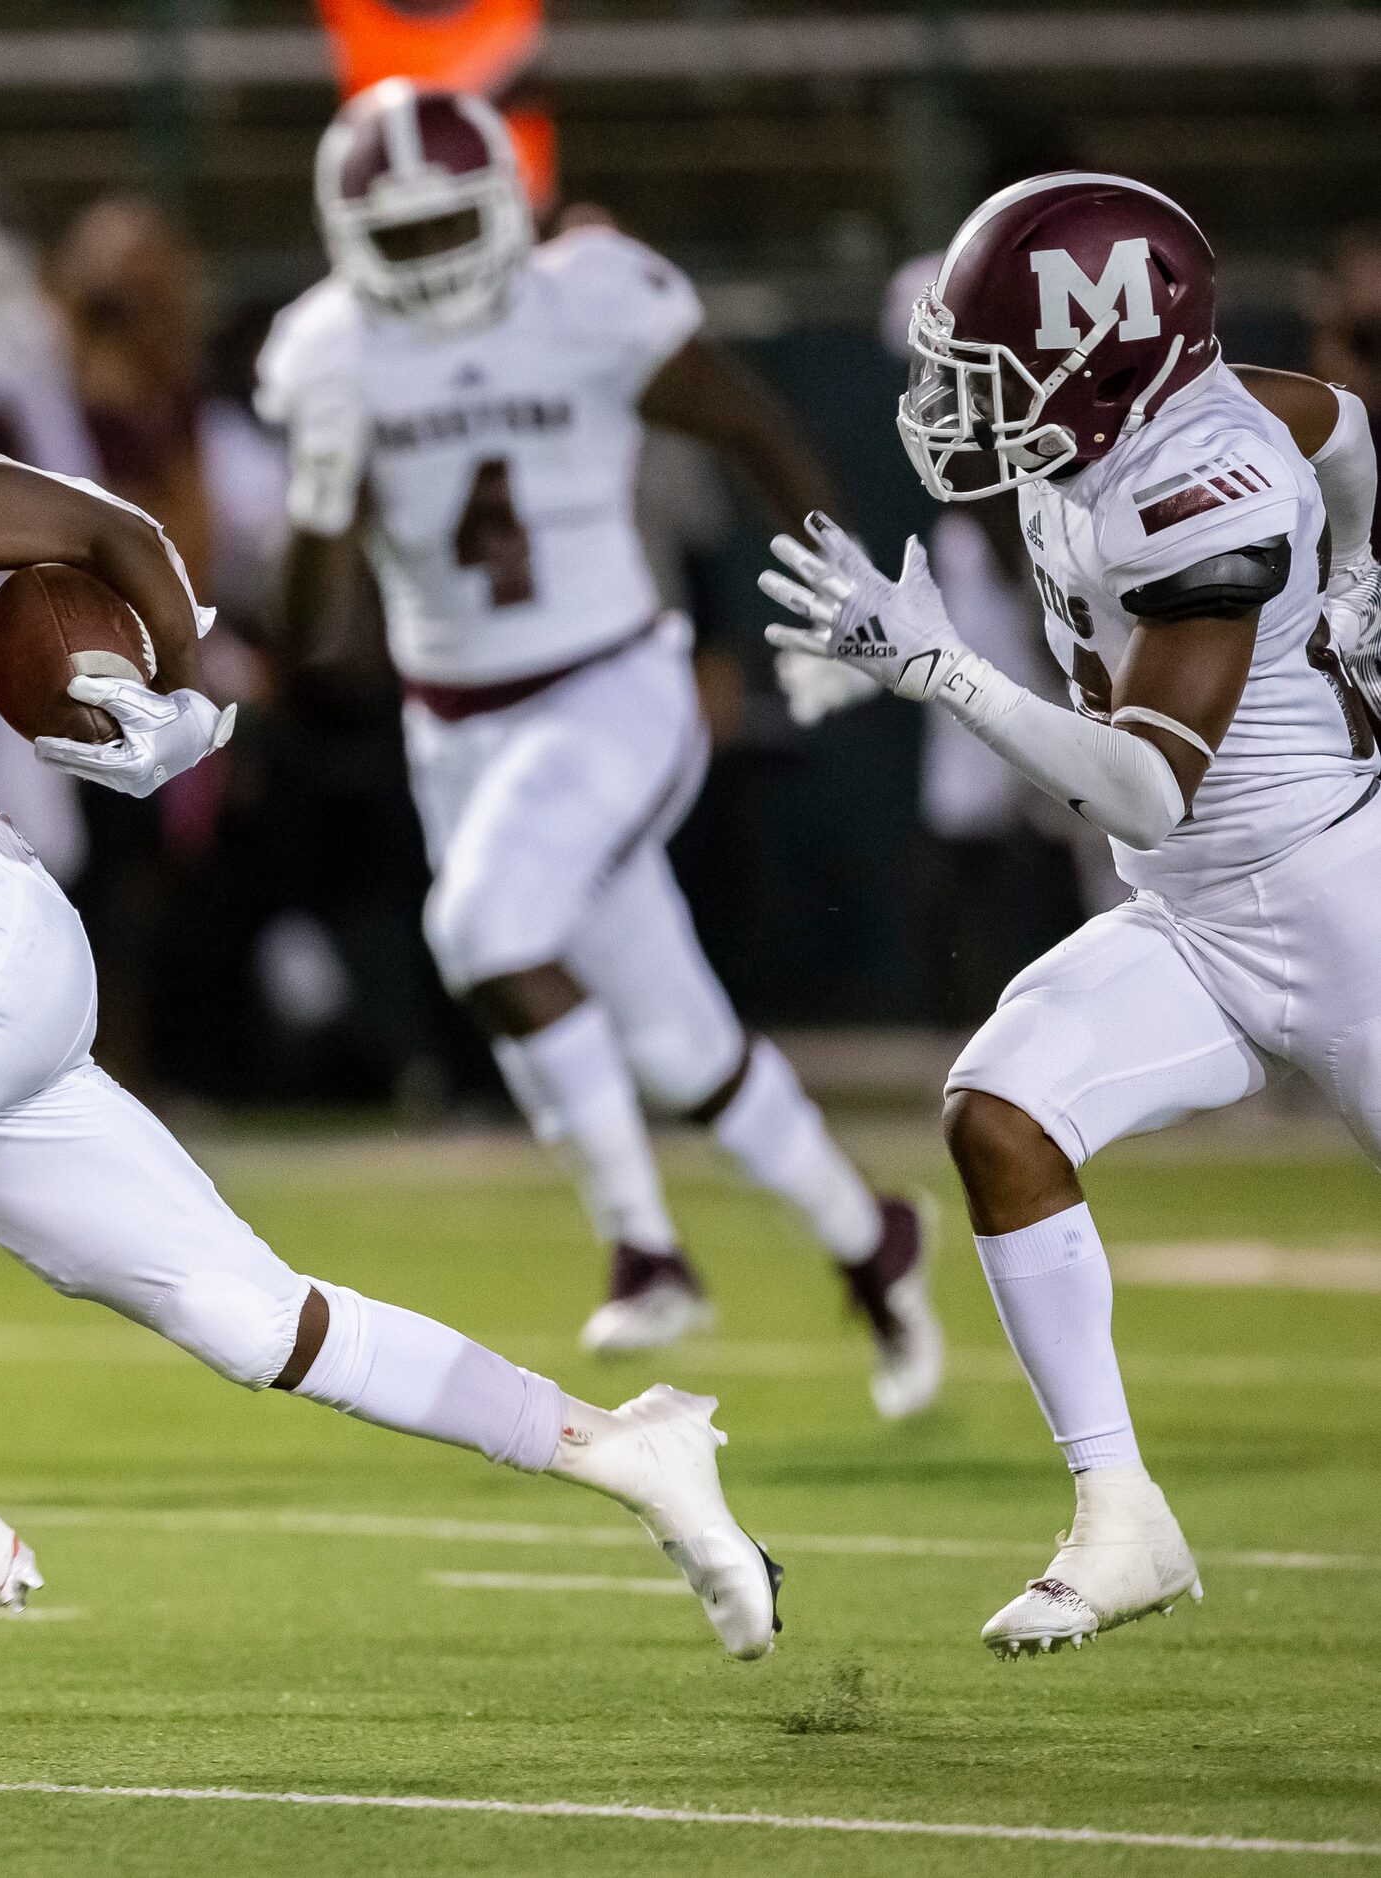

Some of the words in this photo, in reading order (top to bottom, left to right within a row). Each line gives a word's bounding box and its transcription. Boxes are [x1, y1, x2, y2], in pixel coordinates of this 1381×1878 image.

[1029, 237, 1161, 349] M
[456, 459, 535, 608] 4
[838, 643, 898, 658] adidas
